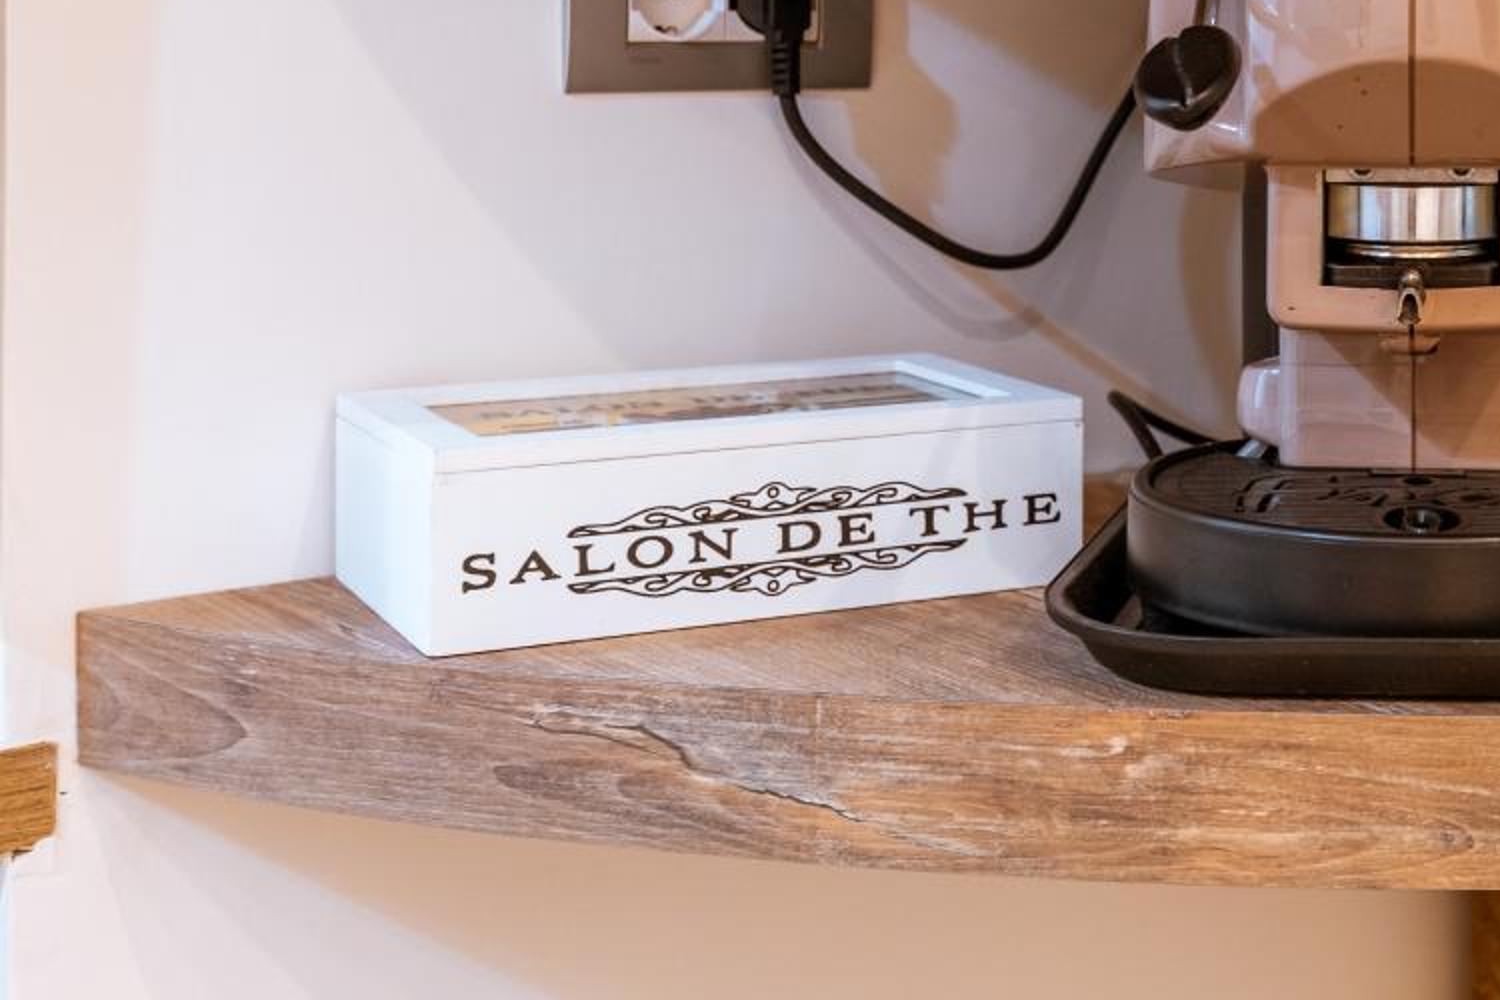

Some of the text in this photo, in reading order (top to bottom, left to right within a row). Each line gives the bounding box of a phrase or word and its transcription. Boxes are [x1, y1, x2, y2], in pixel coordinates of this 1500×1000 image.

[461, 491, 1063, 595] SALON DE THE
